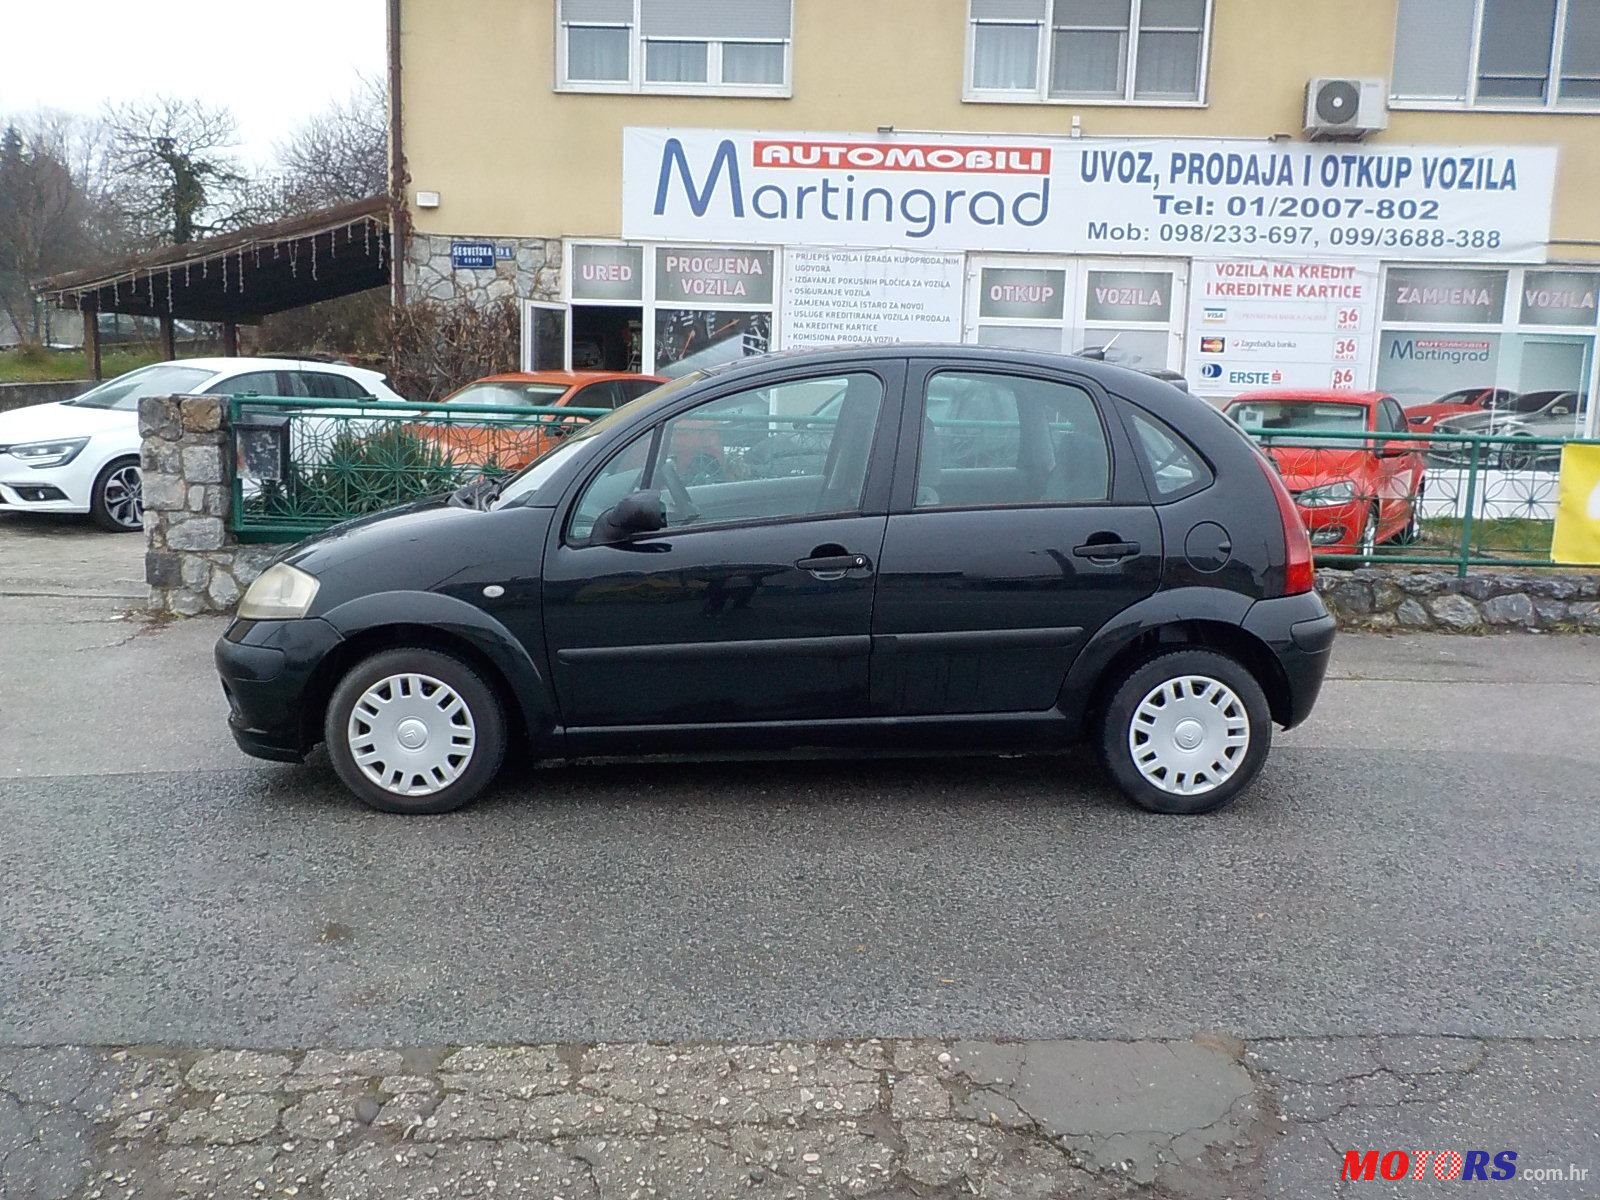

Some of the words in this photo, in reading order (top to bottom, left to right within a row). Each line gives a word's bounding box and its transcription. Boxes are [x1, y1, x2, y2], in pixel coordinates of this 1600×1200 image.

[761, 144, 1043, 171] AUTOMOBILI
[1080, 150, 1160, 190] UVOZ,
[1169, 151, 1294, 188] PRODAJA
[1303, 154, 1311, 187] I
[1320, 154, 1412, 189] OTKUP
[1421, 157, 1518, 191] VOZILA
[653, 138, 1050, 238] Martingrad
[1153, 195, 1215, 217] Tel:
[1227, 196, 1440, 221] 01/2007-802
[1087, 221, 1150, 242] Mob:
[1159, 223, 1320, 248] 098/233-697,
[1329, 226, 1501, 250] 099/3688-388
[665, 256, 763, 275] PROCJENA
[796, 253, 830, 262] PRIJEPIS
[832, 254, 859, 262] VOZILA
[864, 255, 892, 264] IZRADA
[894, 256, 960, 266] KUPOPRODAJNIH
[582, 264, 632, 281] URED
[795, 265, 831, 273] UGOVORA
[1216, 264, 1269, 278] VOZILA
[1274, 265, 1295, 278] NA
[1299, 266, 1356, 280] KREDIT
[681, 278, 746, 296] VOZILA
[795, 276, 836, 284] IZDAVANJE
[838, 278, 878, 286] POKUSNIH
[924, 280, 950, 288] VOZILA
[794, 288, 842, 296] OSIGURANJE
[990, 285, 1054, 302] OTKUP
[1096, 287, 1162, 306] VOZILA
[1206, 283, 1210, 295] I
[1216, 283, 1292, 296] KREDITNE
[1296, 284, 1362, 298] KARTICE
[1396, 288, 1490, 306] ZAMJENA
[900, 303, 924, 311] NOVO)
[1525, 290, 1594, 309] VOZILA
[826, 312, 881, 320] KREDITIRANJA
[916, 314, 950, 322] PRODAJA
[1338, 309, 1358, 324] 36
[806, 323, 844, 331] KREDITNE
[846, 324, 878, 332] KARTICE
[793, 334, 836, 342] KOMISIONA
[838, 334, 872, 343] PRODAJA
[1336, 339, 1356, 354] 36
[1390, 340, 1490, 364] Martingrad
[1230, 372, 1270, 384] ERSTE
